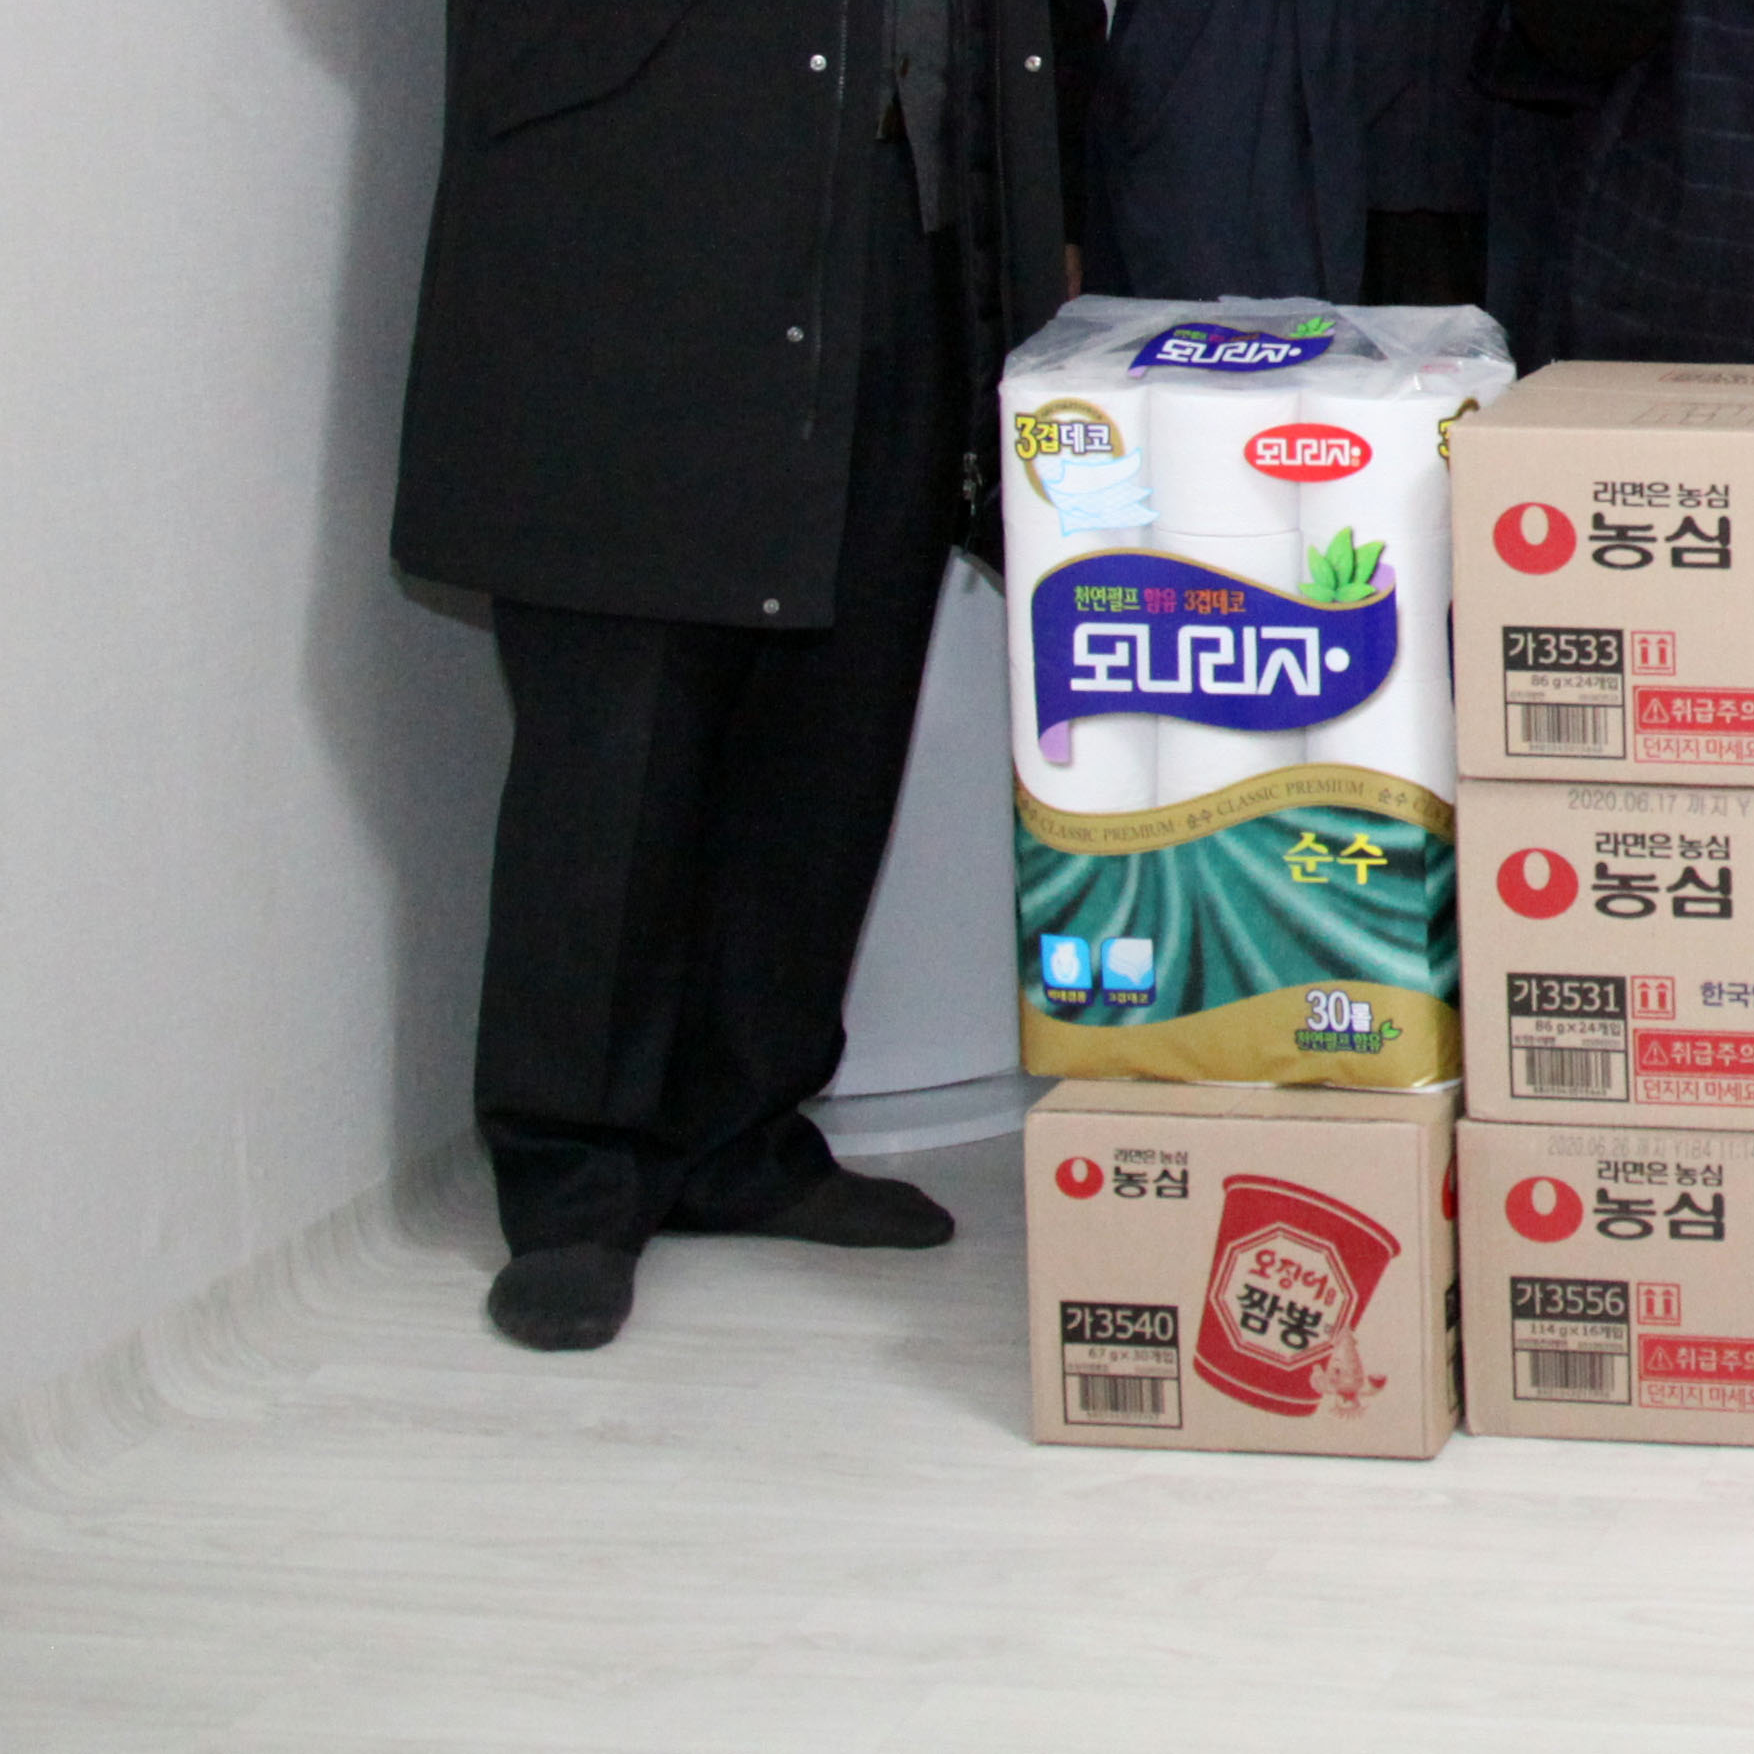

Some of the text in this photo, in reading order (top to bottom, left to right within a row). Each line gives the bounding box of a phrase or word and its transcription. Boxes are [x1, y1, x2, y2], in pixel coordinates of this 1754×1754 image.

[1014, 413, 1111, 460] 3겹데코
[1592, 480, 1731, 509] 라면은 농심
[1587, 513, 1732, 571] 농심
[1508, 632, 1620, 666] 가3533
[1644, 737, 1701, 760] 던지지
[1102, 818, 1176, 843] PREMIUM
[1216, 787, 1281, 817] CLASSIC
[1285, 777, 1365, 797] PREMIUM
[1567, 788, 1678, 814] 2020.06.17
[1687, 794, 1728, 818] 까지
[1283, 832, 1388, 885] 순수
[1594, 831, 1732, 862] 라면은 농심
[1591, 862, 1734, 921] 농심
[1513, 978, 1622, 1013] 가3531
[1643, 1079, 1699, 1103] 던지지
[1112, 1166, 1190, 1199] 농심
[1596, 1159, 1725, 1187] 라면은 농심
[1592, 1187, 1727, 1242] 농심
[1248, 1249, 1328, 1299] 오징어
[1236, 1283, 1323, 1350] 짬뽕
[1515, 1282, 1627, 1317] 가3556
[1065, 1307, 1175, 1342] 가3540
[1646, 1384, 1703, 1408] 던지지
